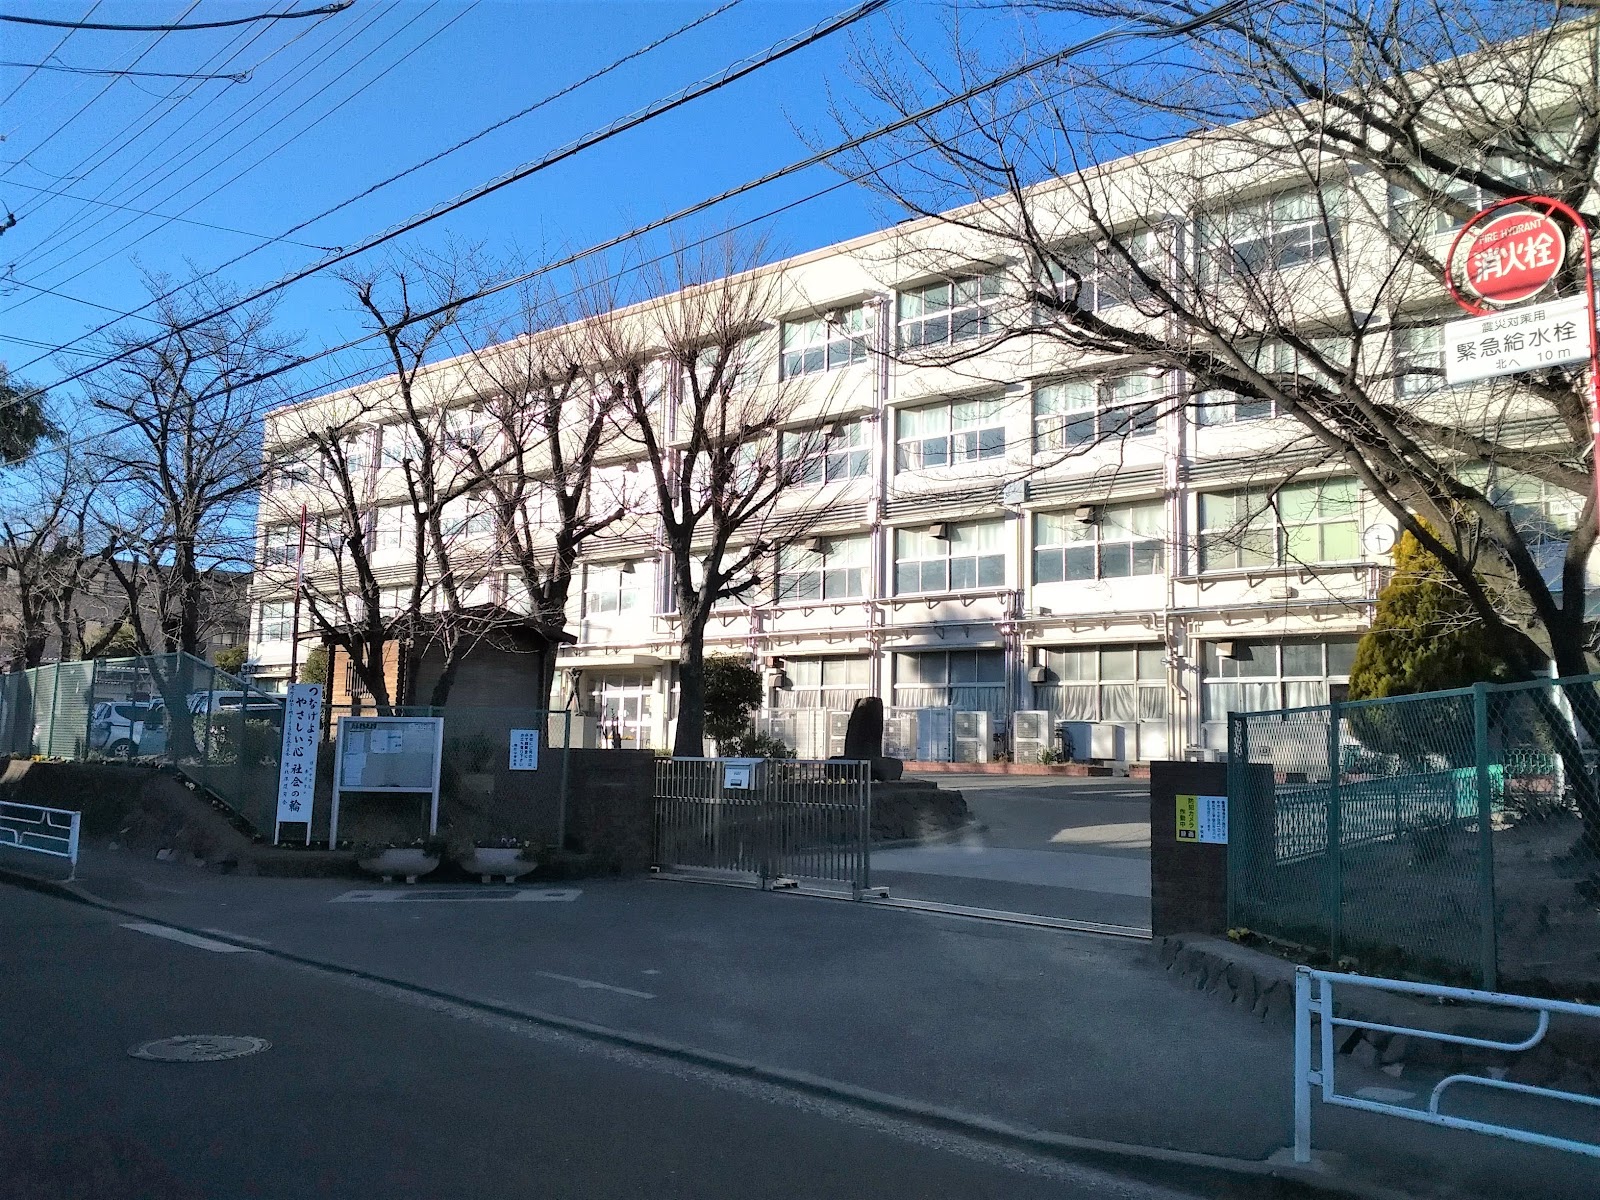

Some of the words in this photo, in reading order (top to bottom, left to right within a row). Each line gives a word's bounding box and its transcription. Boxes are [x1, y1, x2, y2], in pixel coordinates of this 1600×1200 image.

[1478, 230, 1499, 245] FIRE
[1500, 218, 1543, 238] HYDRANT
[1473, 232, 1555, 284] 消火栓
[1456, 321, 1578, 363] 緊急給水栓
[1481, 309, 1546, 334] 震災対策用
[1495, 358, 1521, 370] 北へ
[293, 698, 307, 757] やさしい心
[307, 687, 319, 746] つなげよう
[289, 764, 303, 812] 社会の輪
